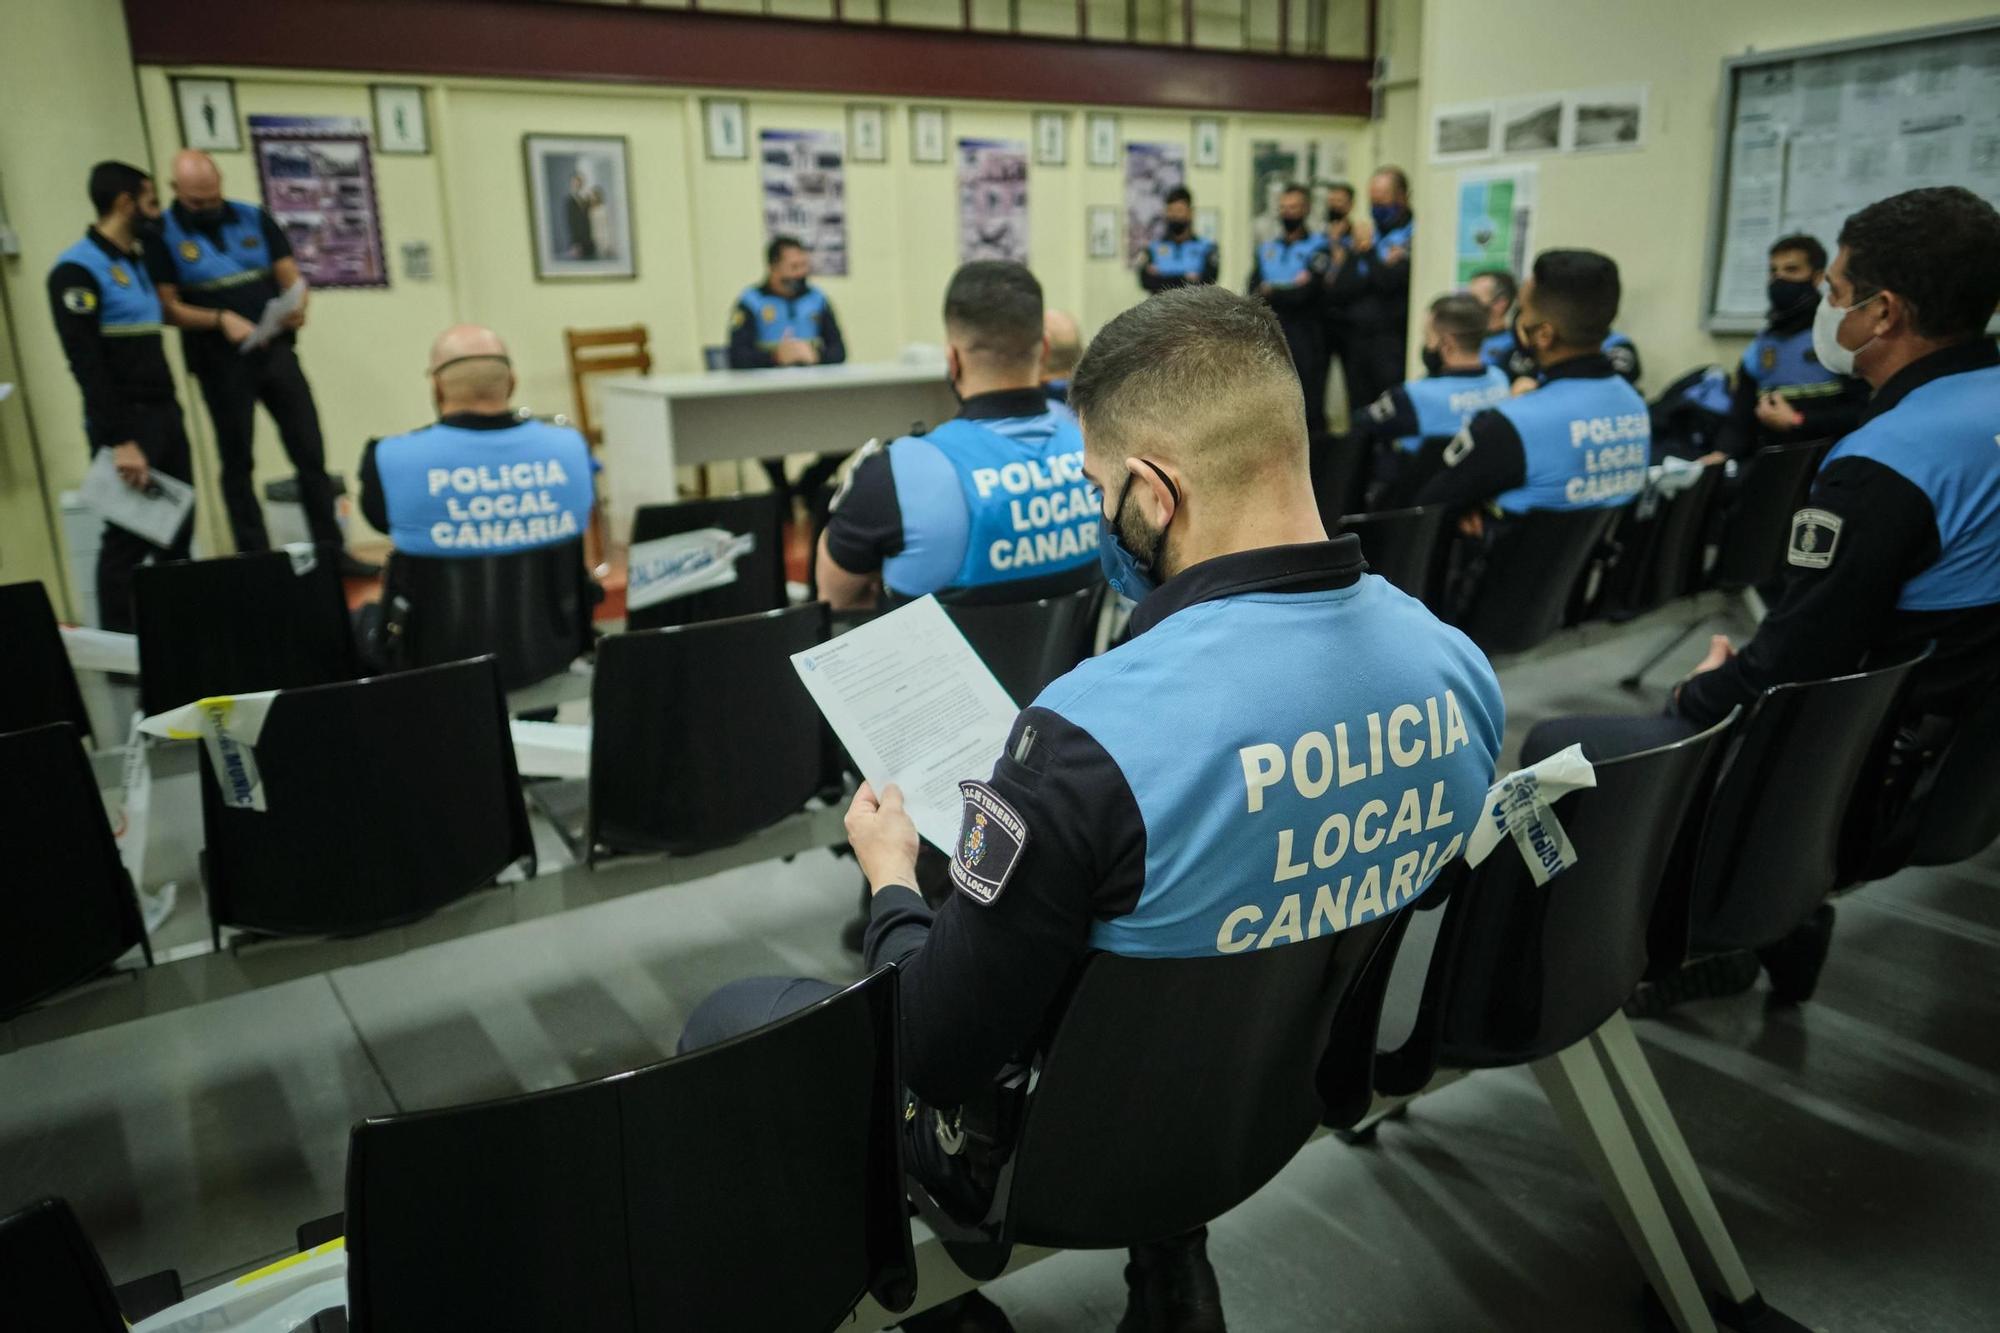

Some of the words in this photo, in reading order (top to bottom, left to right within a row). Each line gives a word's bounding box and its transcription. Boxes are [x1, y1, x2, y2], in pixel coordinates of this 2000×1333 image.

[428, 458, 568, 496] POLICIA
[447, 490, 560, 521] LOCAL
[1010, 485, 1101, 532] LOCAL
[430, 510, 577, 548] CANARIA
[1239, 688, 1470, 813] POLICIA
[981, 795, 1024, 840] TENERIFE
[1272, 780, 1454, 883] LOCAL
[966, 879, 992, 899] LOCAL
[1216, 832, 1464, 954] CANARIA
